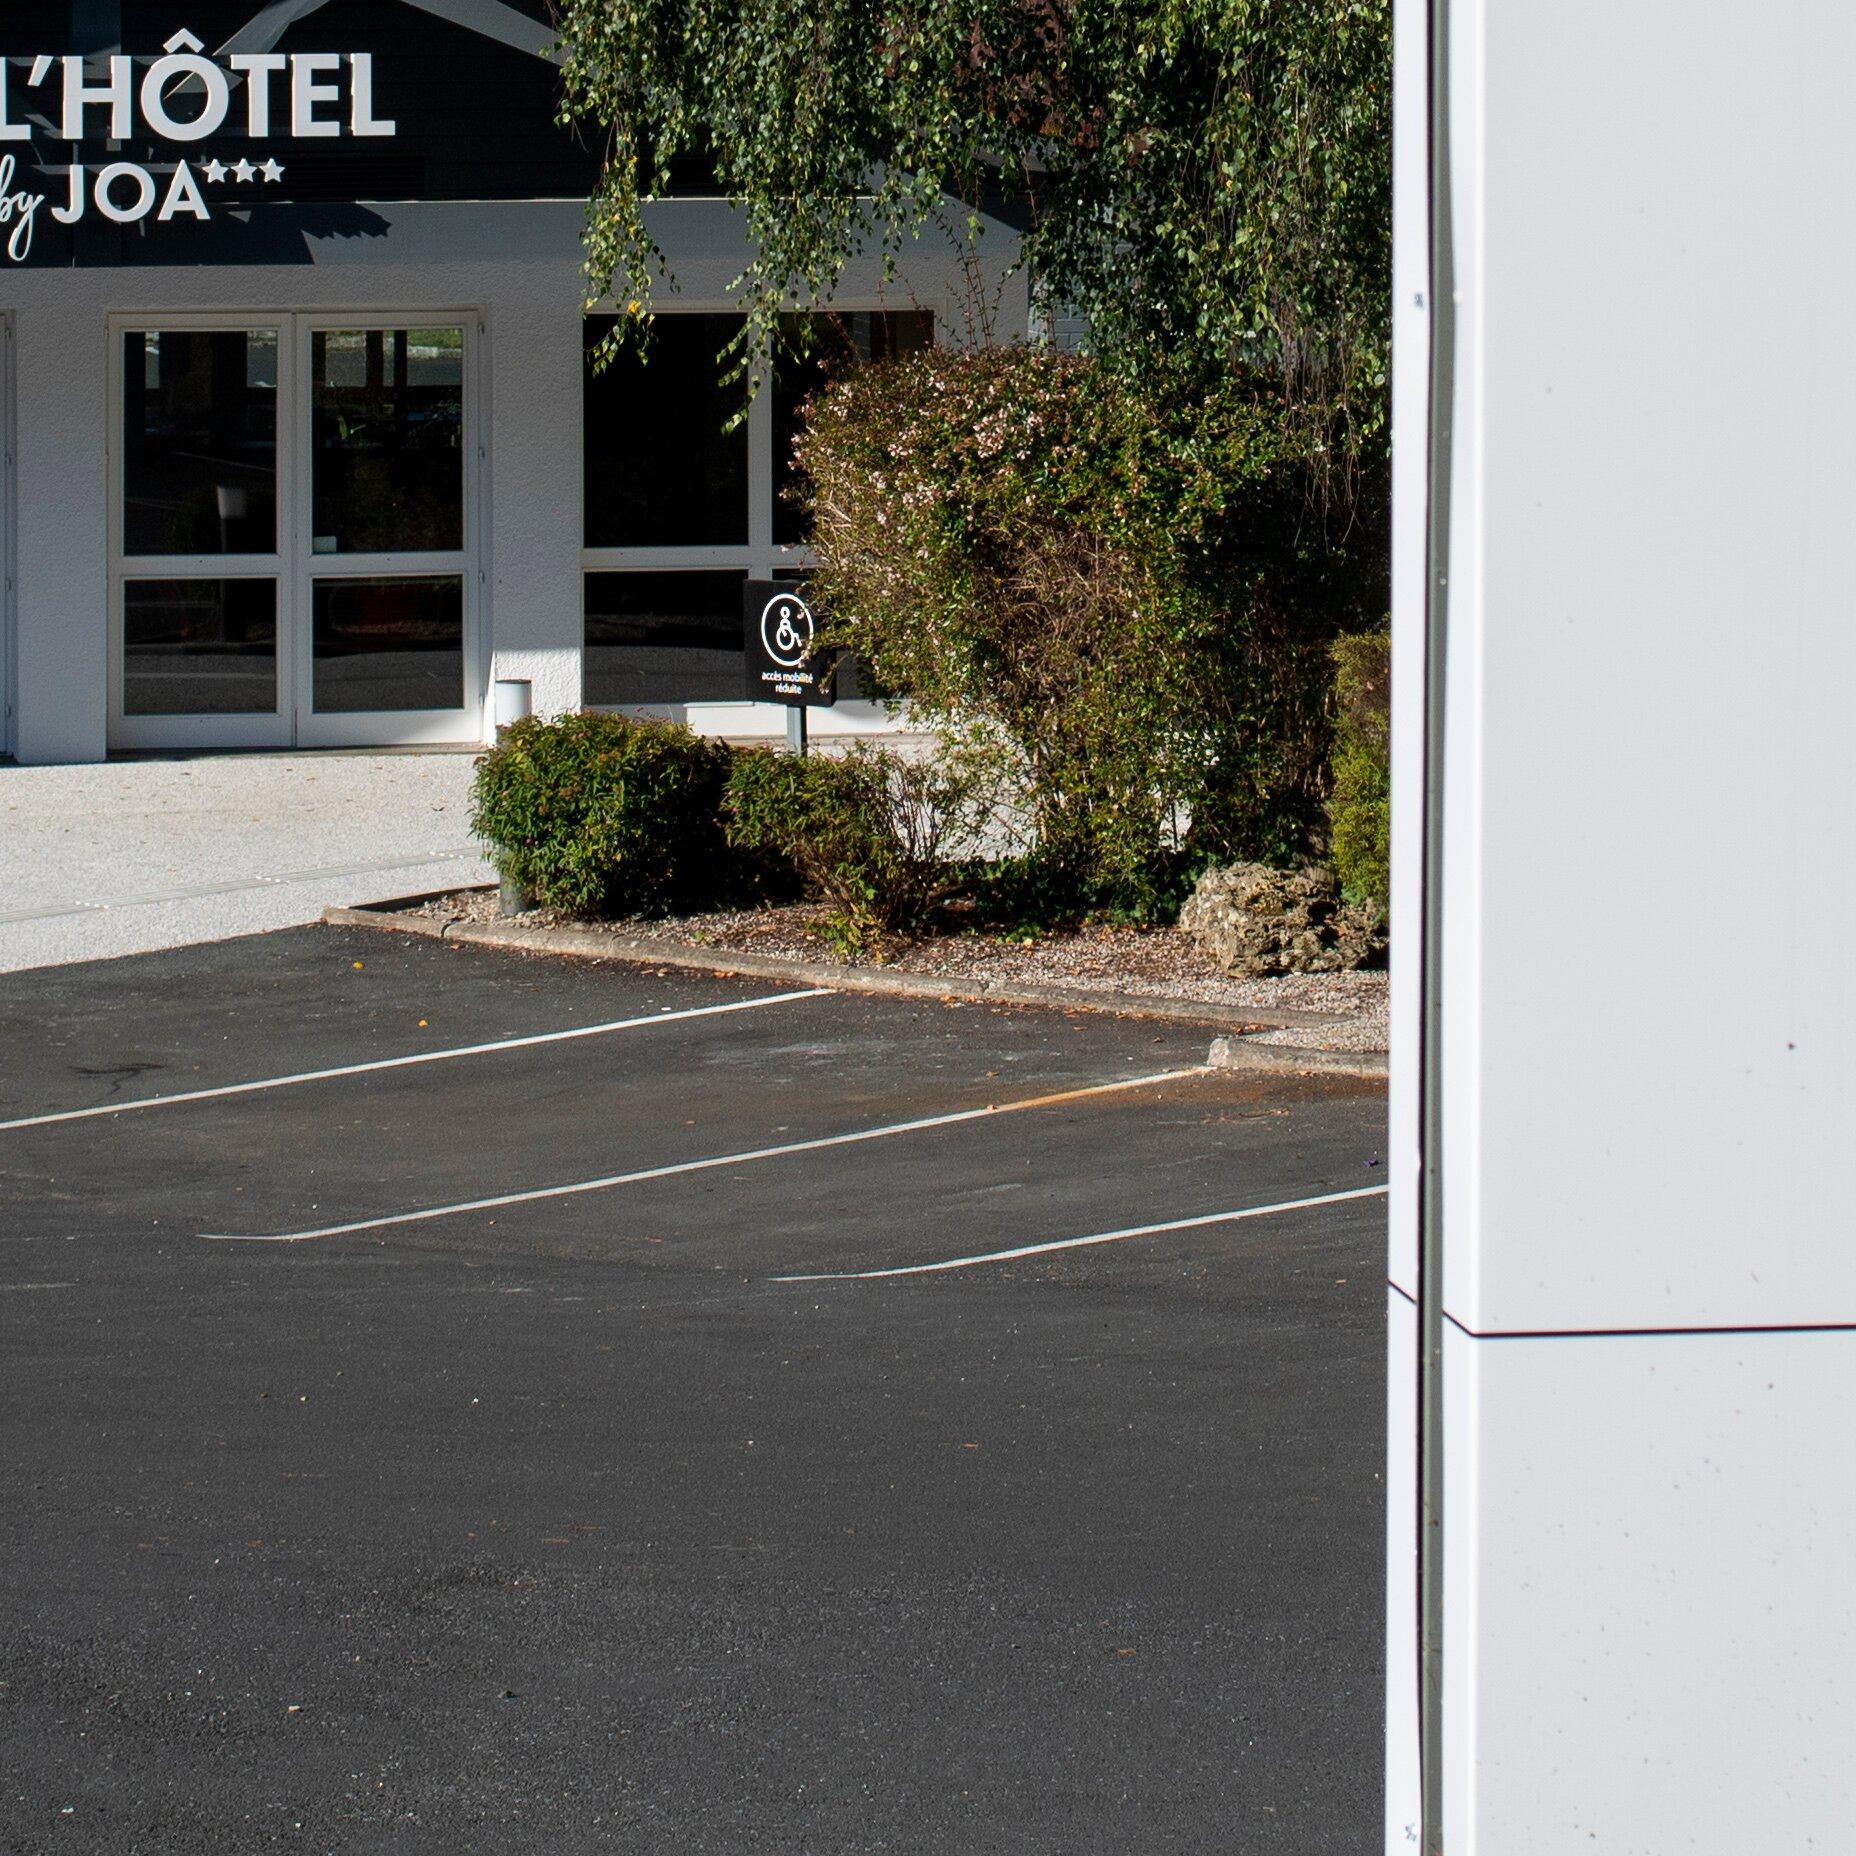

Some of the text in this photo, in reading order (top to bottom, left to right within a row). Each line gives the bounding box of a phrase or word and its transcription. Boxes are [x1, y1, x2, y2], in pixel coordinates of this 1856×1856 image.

[51, 158, 211, 224] JOA
[761, 669, 814, 684] accès mobilité
[775, 682, 803, 695] réduite
